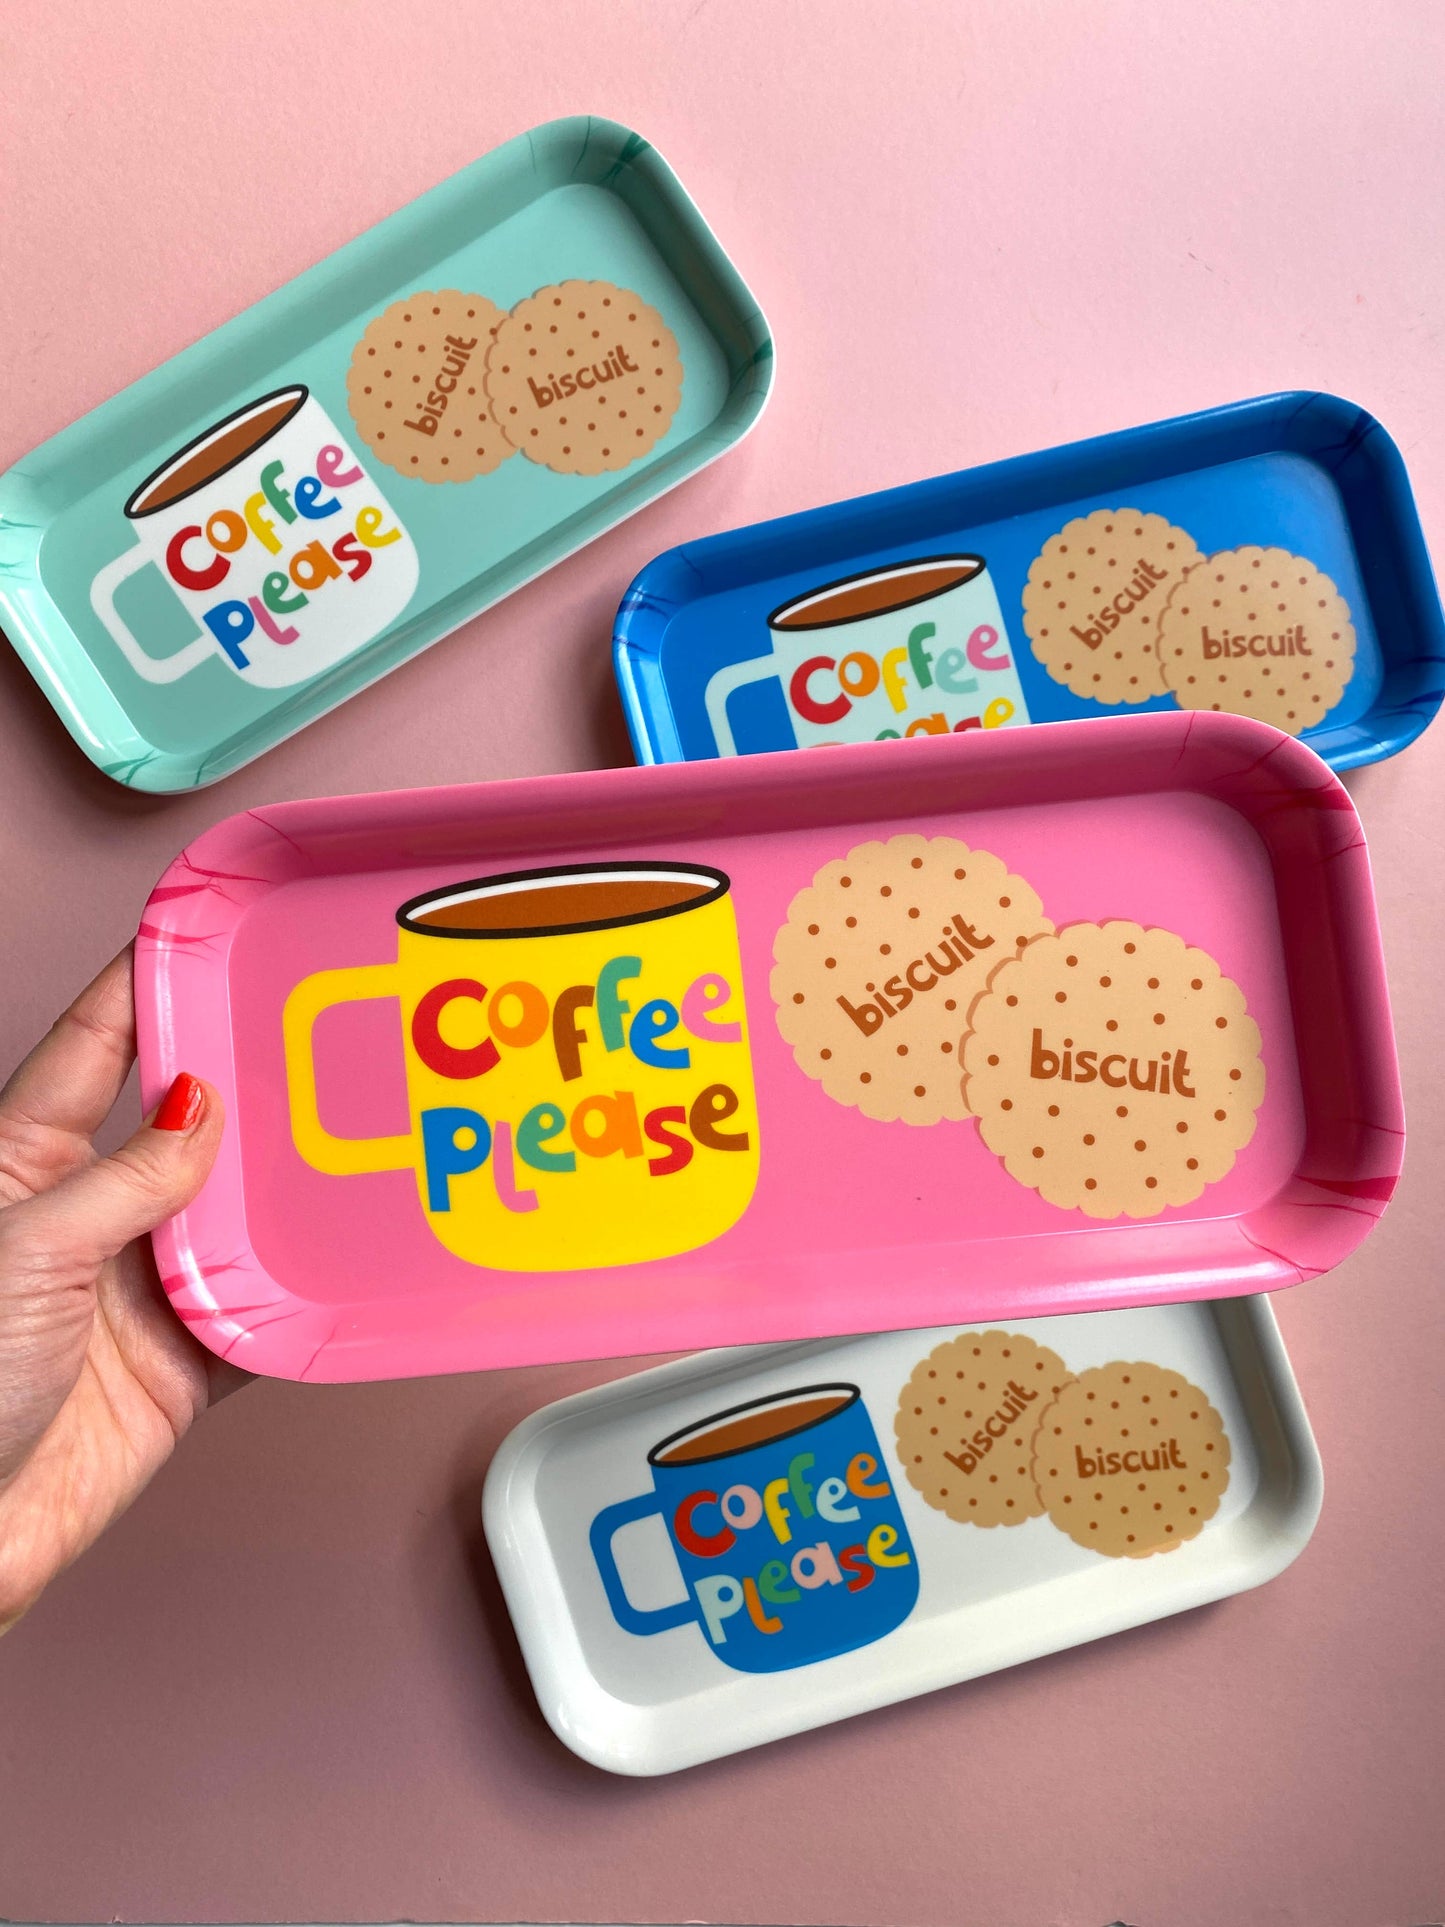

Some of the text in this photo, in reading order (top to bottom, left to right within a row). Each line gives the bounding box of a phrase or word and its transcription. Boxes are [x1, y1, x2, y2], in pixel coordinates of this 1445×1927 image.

[403, 333, 478, 437] biscuit
[526, 344, 640, 409] biscuit
[165, 444, 364, 591] Coffee
[1069, 558, 1167, 650] biscuit
[1201, 625, 1313, 660] biscuit
[789, 621, 1011, 725] Coffee
[411, 956, 742, 1082] Coffee
[837, 914, 995, 1037] biscuit
[1030, 1028, 1197, 1099] biscuit
[943, 1379, 1039, 1476] biscuit
[1075, 1438, 1187, 1479] biscuit
[673, 1453, 890, 1558] Coffee
